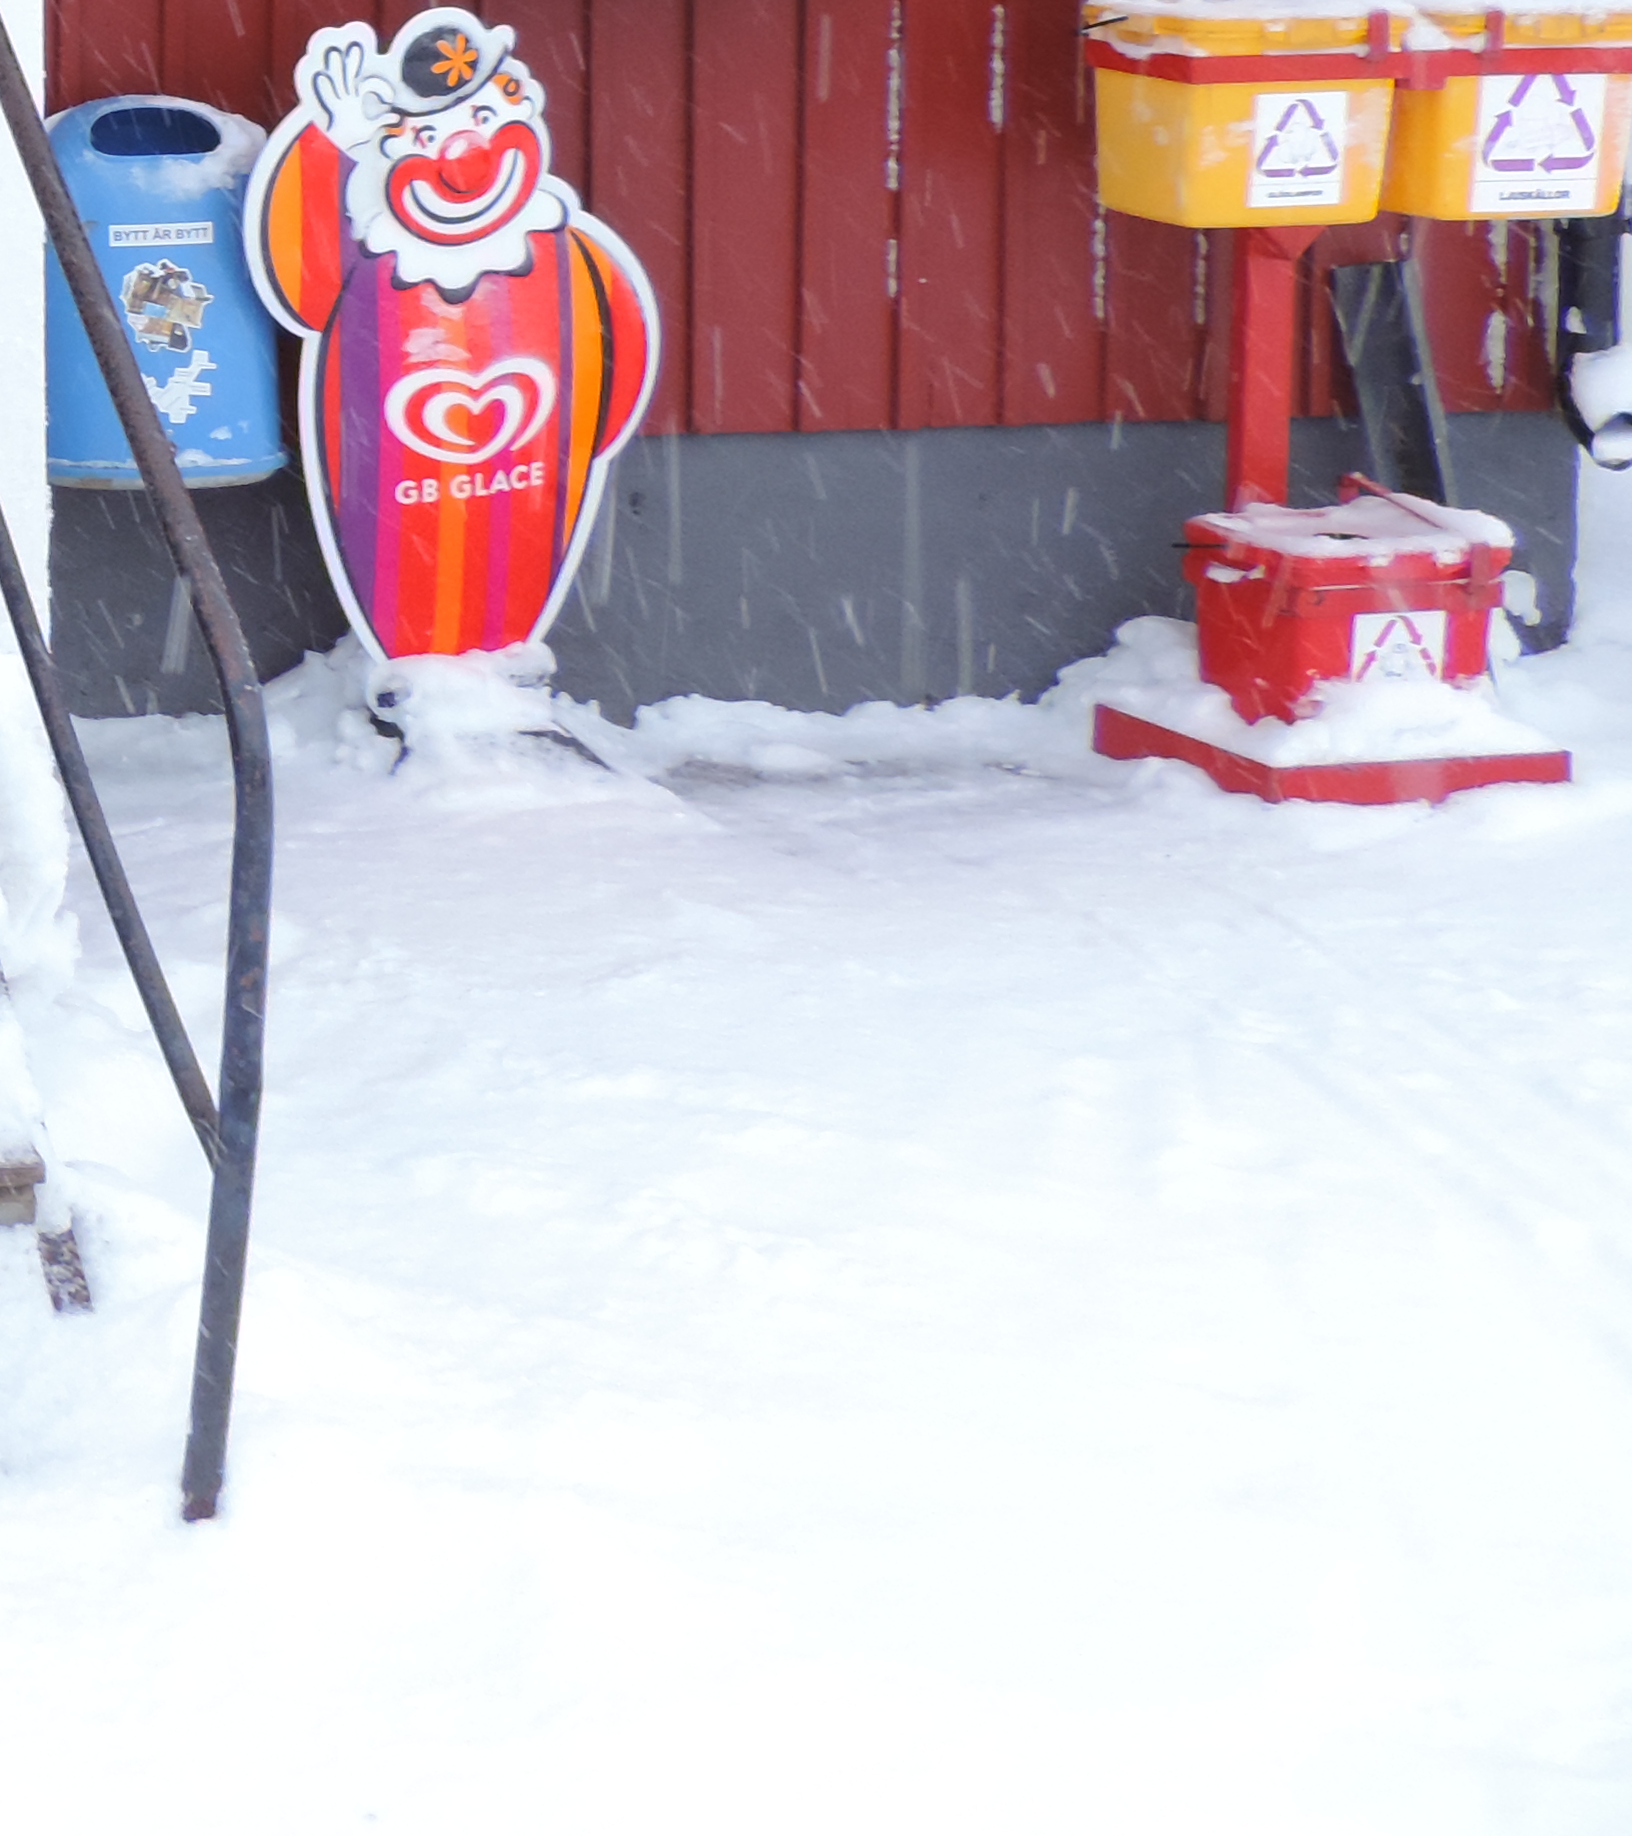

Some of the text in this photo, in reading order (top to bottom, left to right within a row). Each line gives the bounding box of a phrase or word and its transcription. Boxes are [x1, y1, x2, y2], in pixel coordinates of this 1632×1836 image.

[113, 230, 149, 243] BYTT
[176, 226, 209, 240] BYTT
[394, 461, 545, 505] GB GLACE
